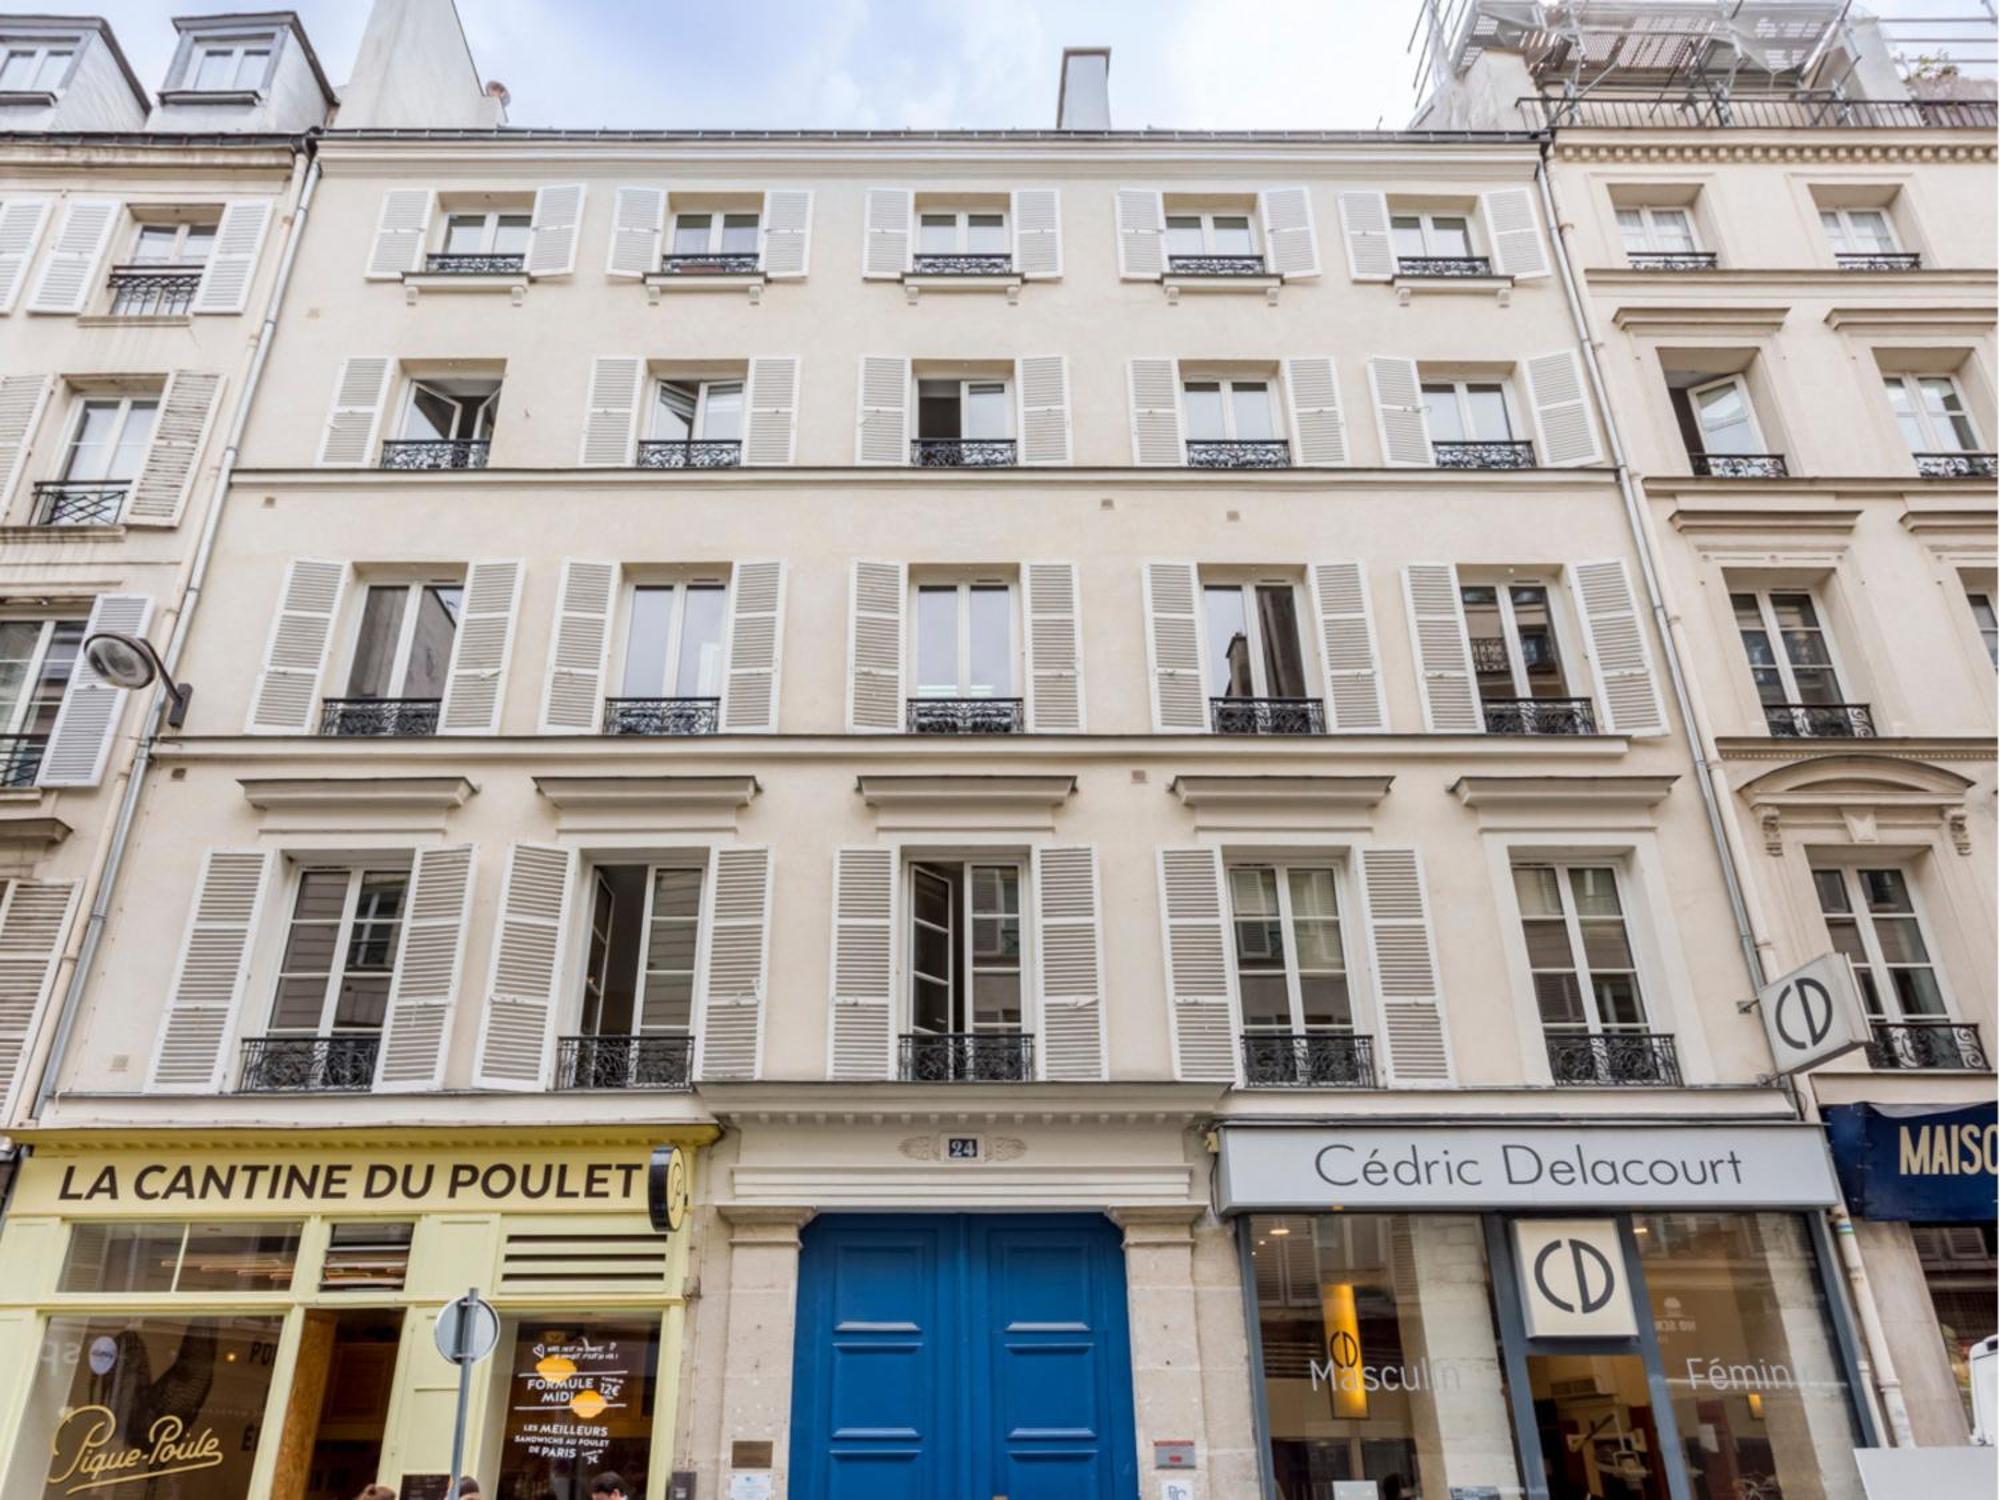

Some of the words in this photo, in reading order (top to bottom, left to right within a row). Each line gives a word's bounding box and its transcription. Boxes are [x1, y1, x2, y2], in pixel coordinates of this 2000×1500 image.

[951, 1140, 976, 1157] 24
[1899, 1123, 1998, 1176] MAISO
[1314, 1143, 1483, 1187] Cédric
[1501, 1143, 1742, 1186] Delacourt
[58, 1164, 119, 1200] LA
[134, 1164, 353, 1201] CANTINE
[363, 1163, 436, 1199] DU
[447, 1162, 643, 1199] POULET
[527, 1378, 594, 1390] FORMULE
[48, 1405, 222, 1484] Pique-Poule
[540, 1424, 609, 1438] MEILLEURS
[541, 1447, 577, 1459] PARIS
